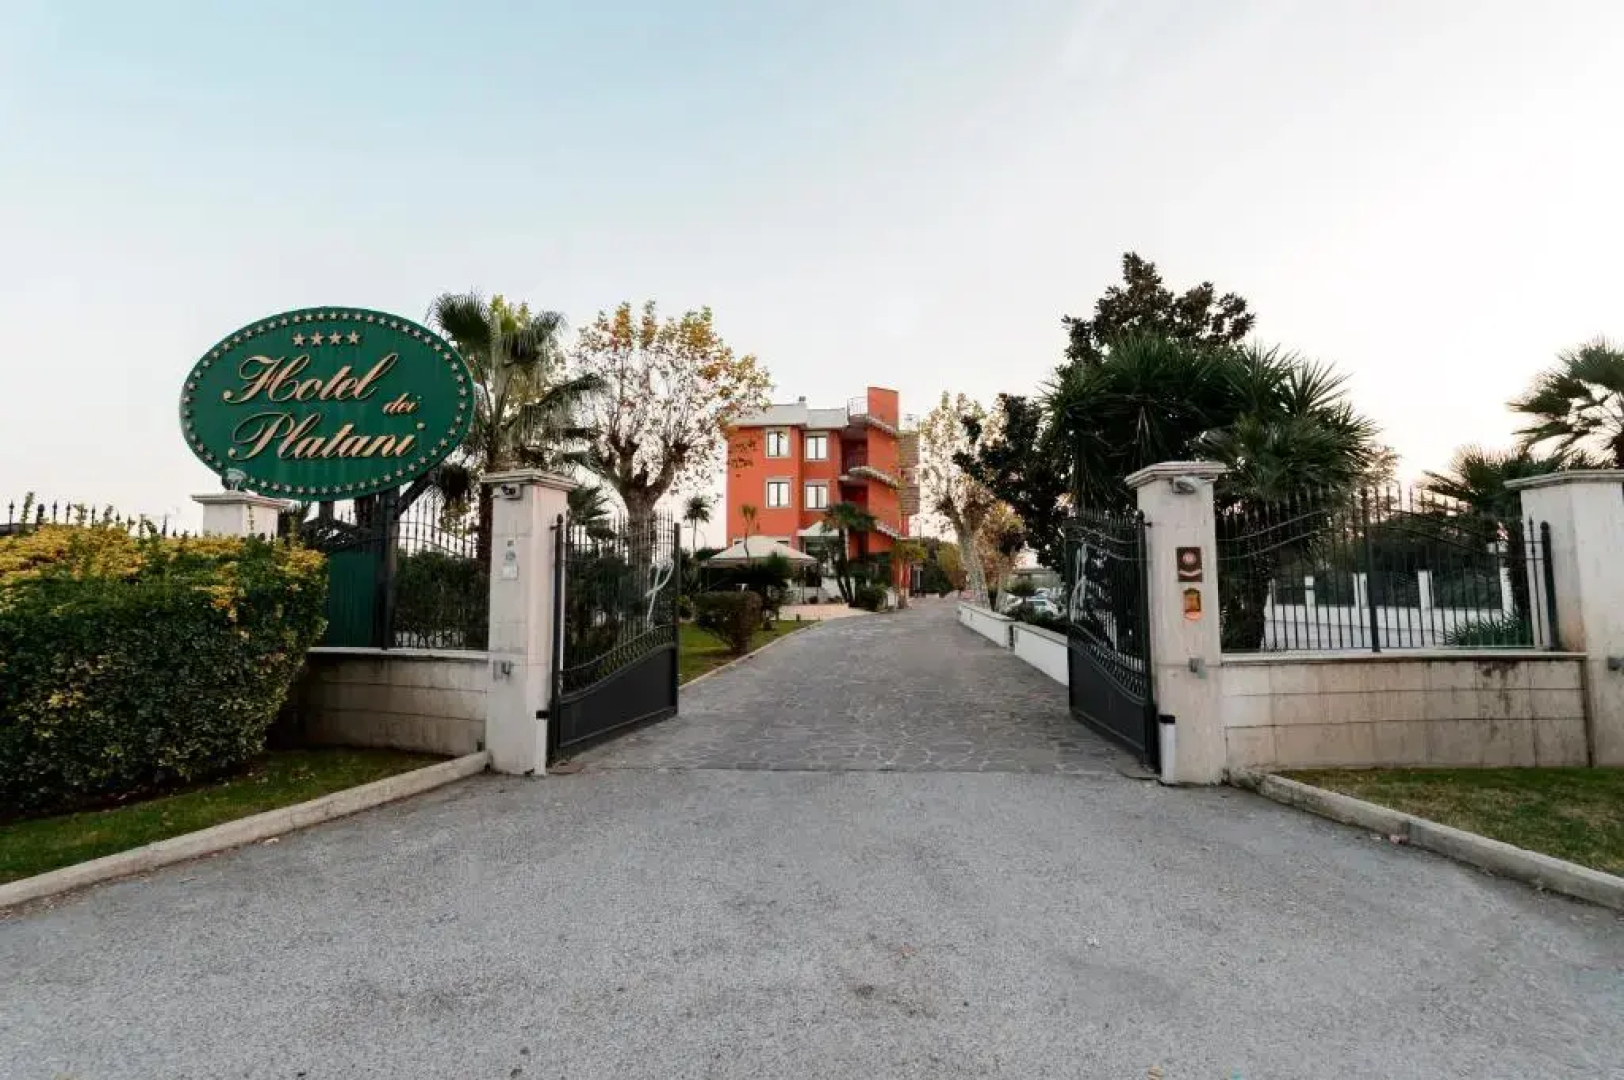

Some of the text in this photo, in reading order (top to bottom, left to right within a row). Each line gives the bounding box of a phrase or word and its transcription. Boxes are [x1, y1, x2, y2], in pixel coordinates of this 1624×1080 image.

[223, 353, 399, 404] Hotel
[382, 393, 422, 415] dei
[227, 411, 426, 461] Platani
